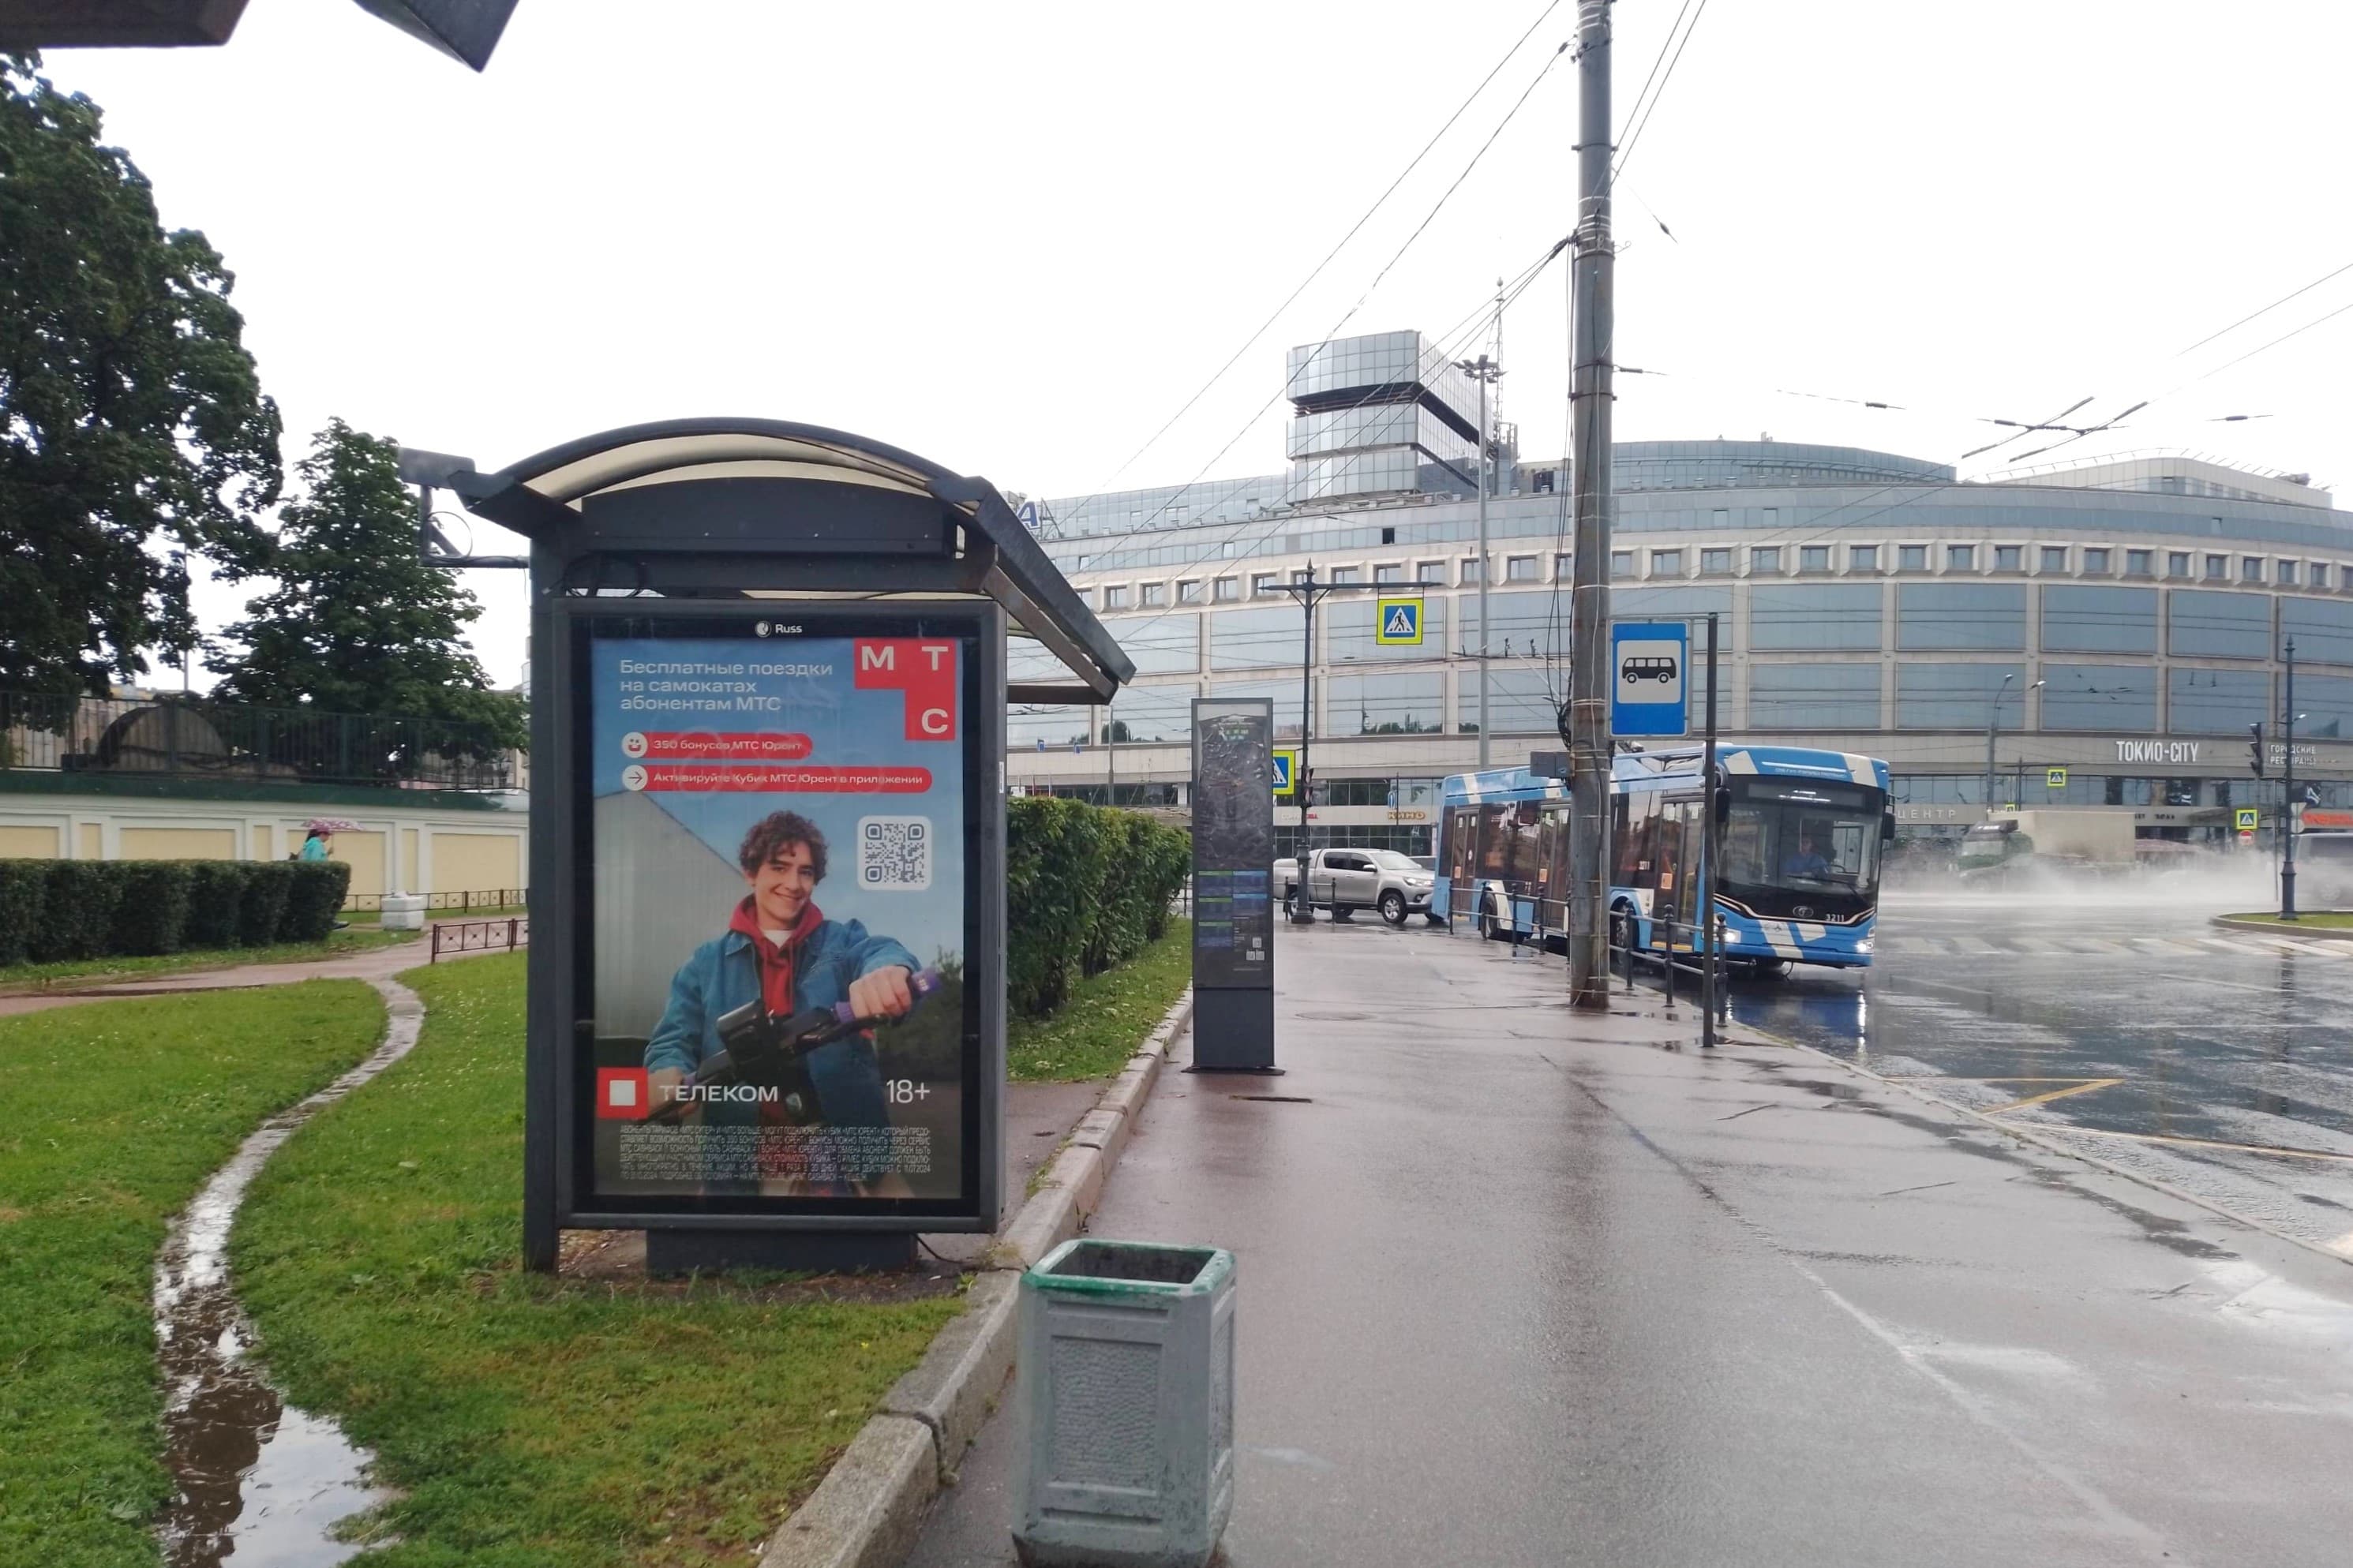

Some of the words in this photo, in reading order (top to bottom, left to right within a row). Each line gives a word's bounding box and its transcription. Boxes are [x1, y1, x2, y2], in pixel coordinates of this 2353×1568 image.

[775, 623, 803, 634] Russ
[620, 660, 744, 675] Бесплатные
[749, 664, 833, 677] поездки
[620, 680, 644, 692] на
[648, 680, 758, 693] самокатах
[620, 694, 732, 710] абонентам
[736, 696, 781, 711] МТС
[654, 740, 677, 750] 350
[680, 739, 730, 752] бонусов
[731, 740, 759, 750] МТС
[762, 741, 802, 752] Юрент
[2115, 740, 2198, 762] ТОКИО-CITY
[2270, 744, 2317, 754] ГОРДСКИЕ
[654, 772, 730, 784] Активируйте
[732, 773, 767, 784] Кубик
[770, 774, 796, 783] МТС
[799, 773, 837, 785] Юрент
[849, 776, 923, 785] приложении
[1388, 810, 1426, 820] КИНО
[1825, 913, 1845, 922] 3211
[658, 1084, 778, 1102] ТЕЛЕКОМ
[886, 1079, 931, 1105] 18+
